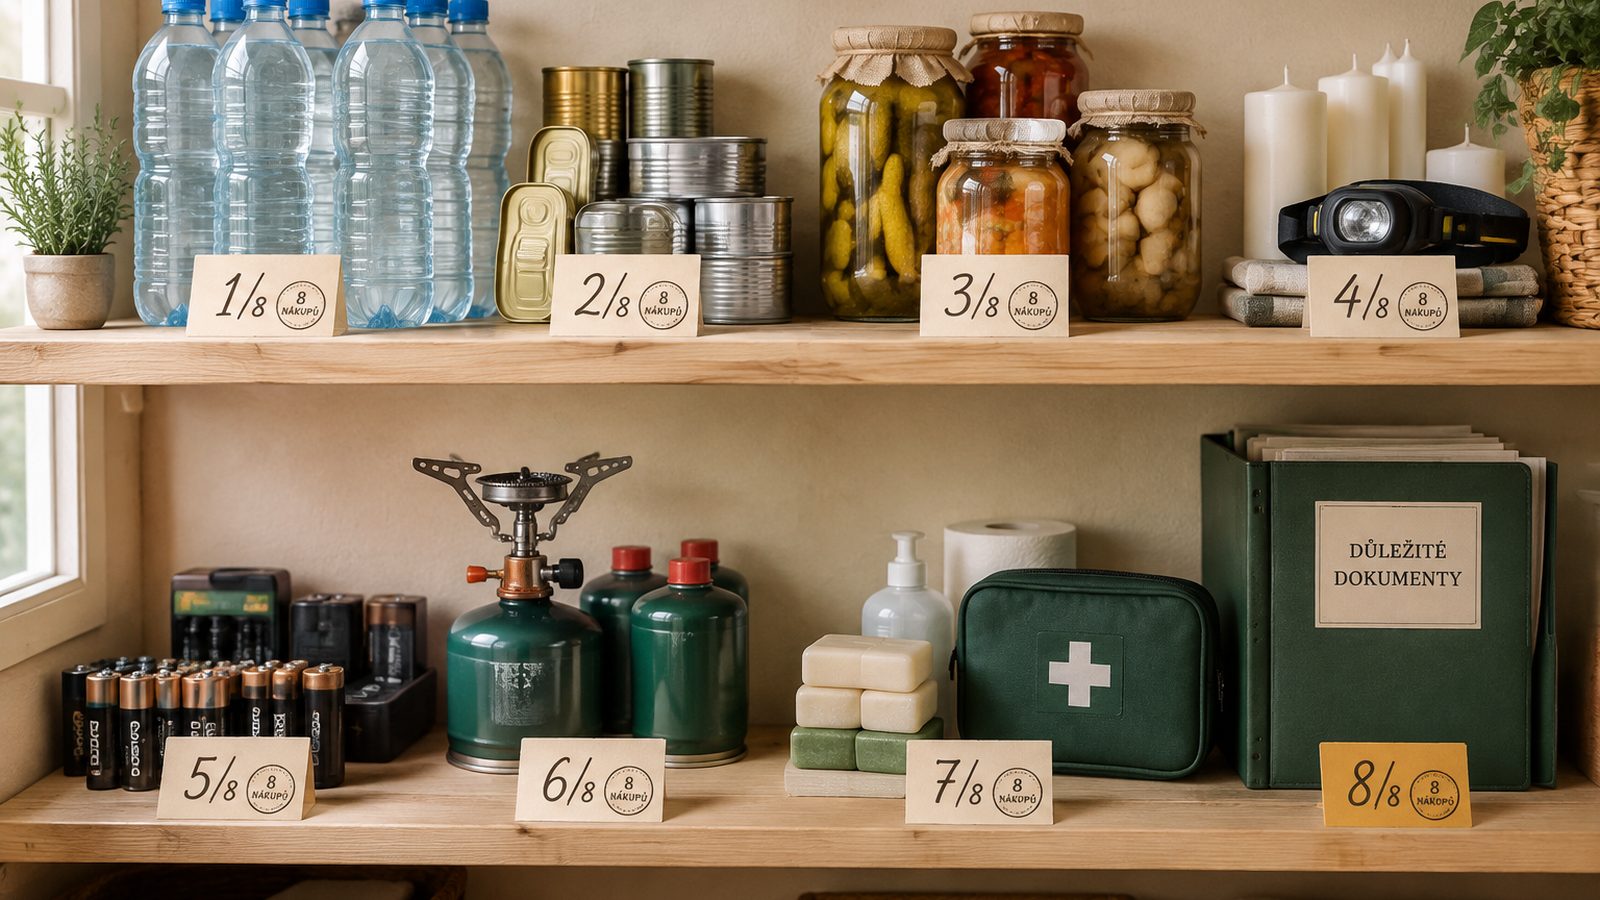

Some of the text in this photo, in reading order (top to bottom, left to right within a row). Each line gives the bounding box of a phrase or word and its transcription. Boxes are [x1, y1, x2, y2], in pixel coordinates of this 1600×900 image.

[216, 272, 267, 320] 1/8
[296, 291, 306, 304] 8
[575, 272, 630, 319] 2/8
[659, 291, 668, 304] 8
[944, 272, 999, 320] 3/8
[1028, 291, 1038, 305] 8
[1334, 273, 1389, 320] 4/8
[1418, 292, 1427, 306] 8
[1350, 539, 1446, 558] DŮLEŽITÉ
[1334, 571, 1462, 586] DOKUMENTY
[184, 755, 238, 804] 5/8
[267, 775, 276, 789] 8
[543, 756, 595, 806] 6/8
[624, 776, 633, 790] 8
[935, 759, 983, 808] 7/8
[1013, 778, 1022, 792] 8
[1348, 760, 1400, 810] 8/8
[1430, 780, 1439, 794] 8
